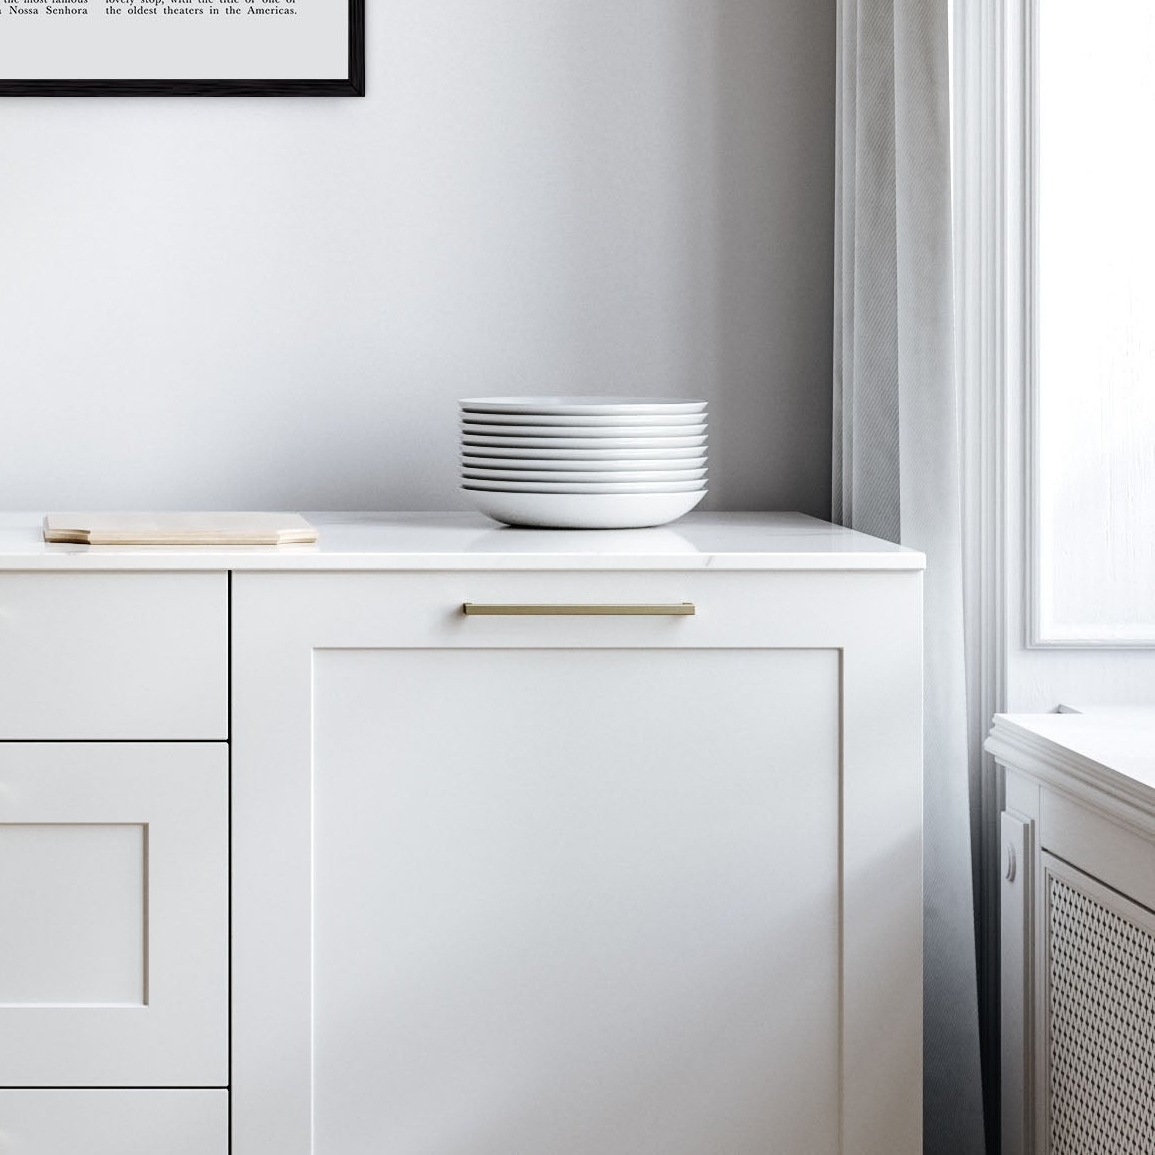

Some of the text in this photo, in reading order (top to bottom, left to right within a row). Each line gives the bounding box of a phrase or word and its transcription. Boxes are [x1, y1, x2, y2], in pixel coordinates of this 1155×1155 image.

[9, 6, 39, 14] Nossa
[46, 6, 88, 14] Senhora
[106, 6, 297, 14] the oldest theaters in the Americas.
